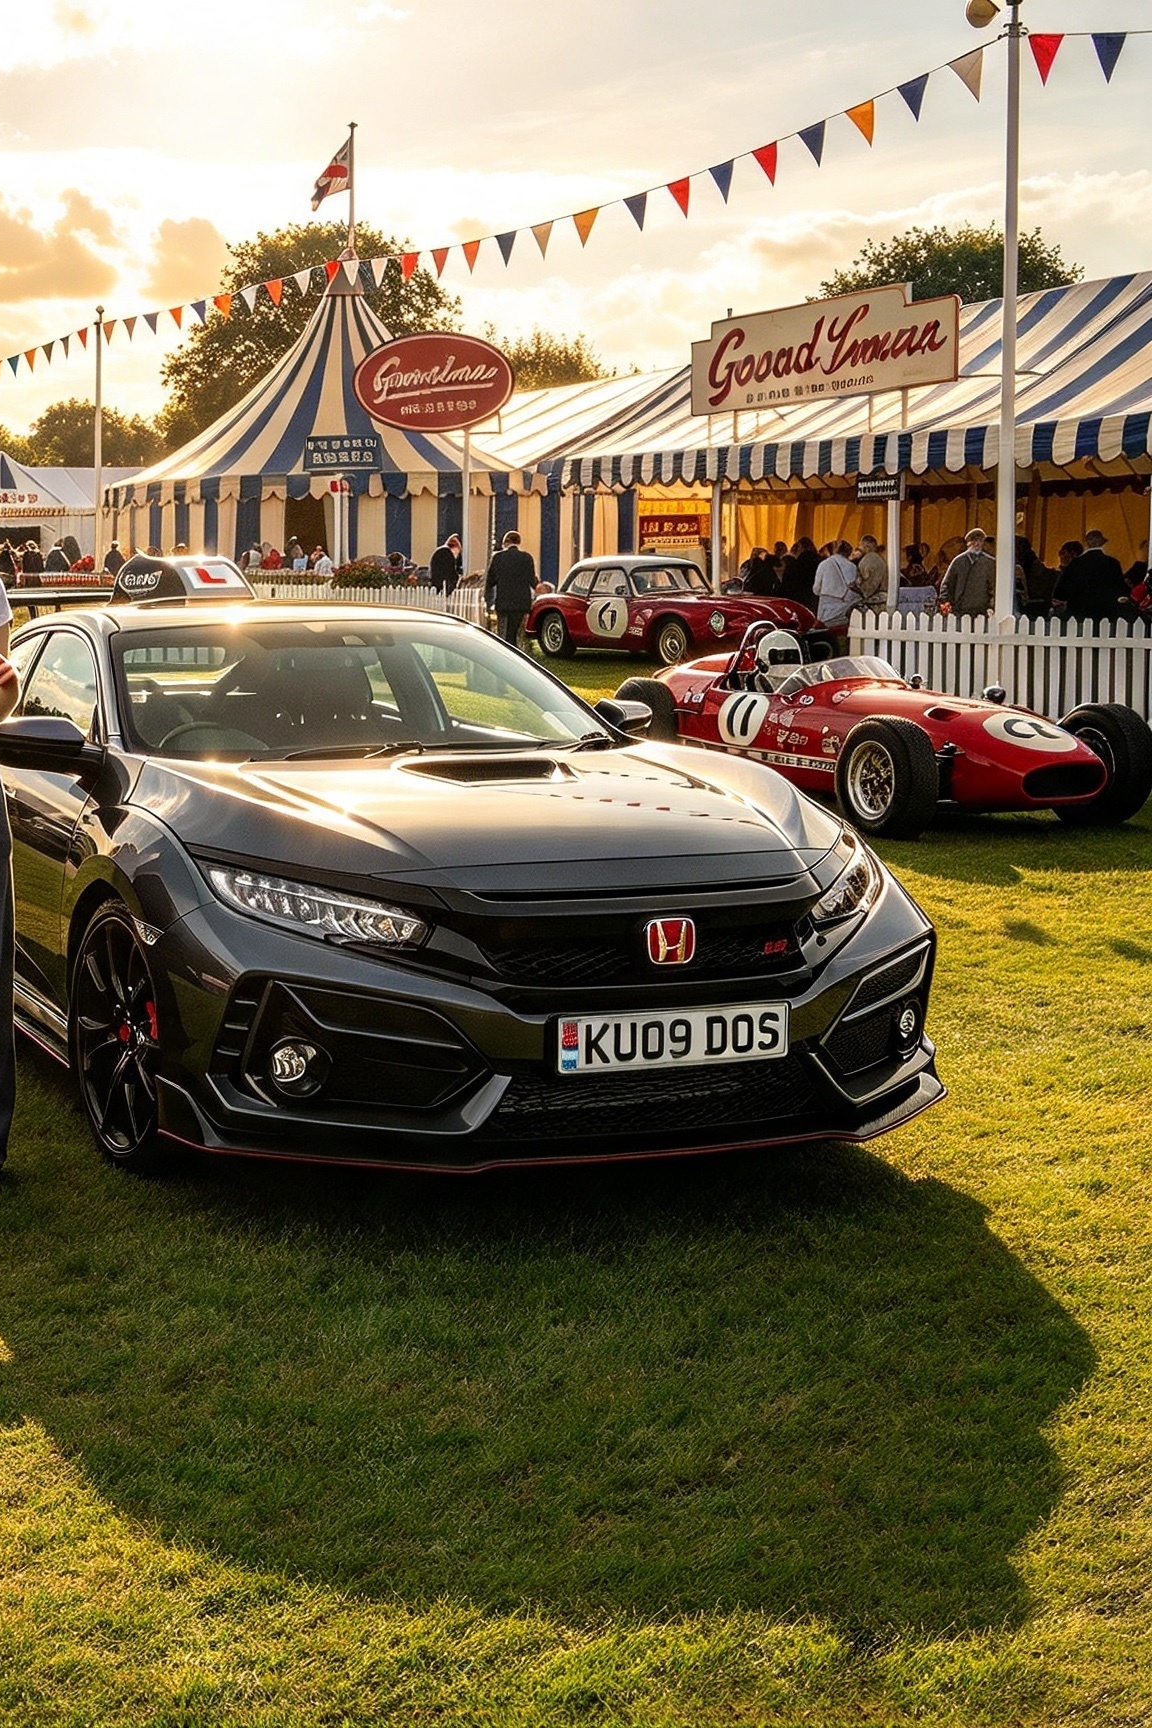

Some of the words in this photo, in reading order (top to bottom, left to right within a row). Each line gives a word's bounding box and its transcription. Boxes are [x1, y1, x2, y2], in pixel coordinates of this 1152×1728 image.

[195, 567, 227, 584] L
[726, 694, 759, 738] 11
[584, 1018, 692, 1065] KU09
[704, 1012, 780, 1056] DOS
